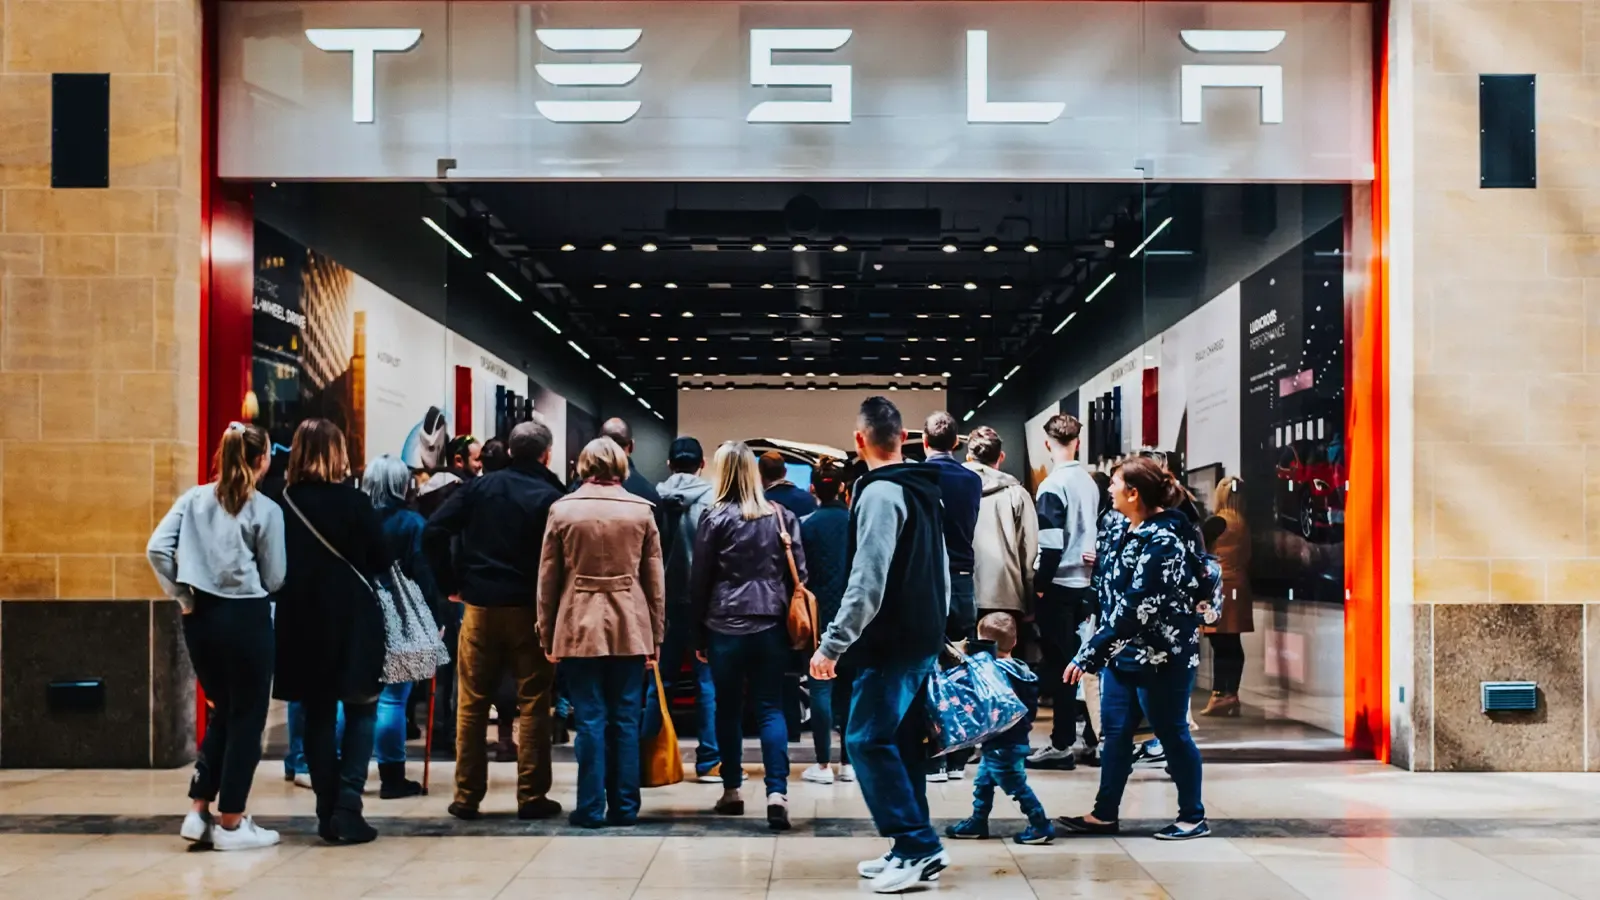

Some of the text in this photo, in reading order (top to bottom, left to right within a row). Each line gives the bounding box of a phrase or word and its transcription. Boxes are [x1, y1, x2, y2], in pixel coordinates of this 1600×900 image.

[304, 28, 1287, 124] TESLA
[254, 275, 280, 298] ECTRIC
[285, 308, 307, 330] DRIVE
